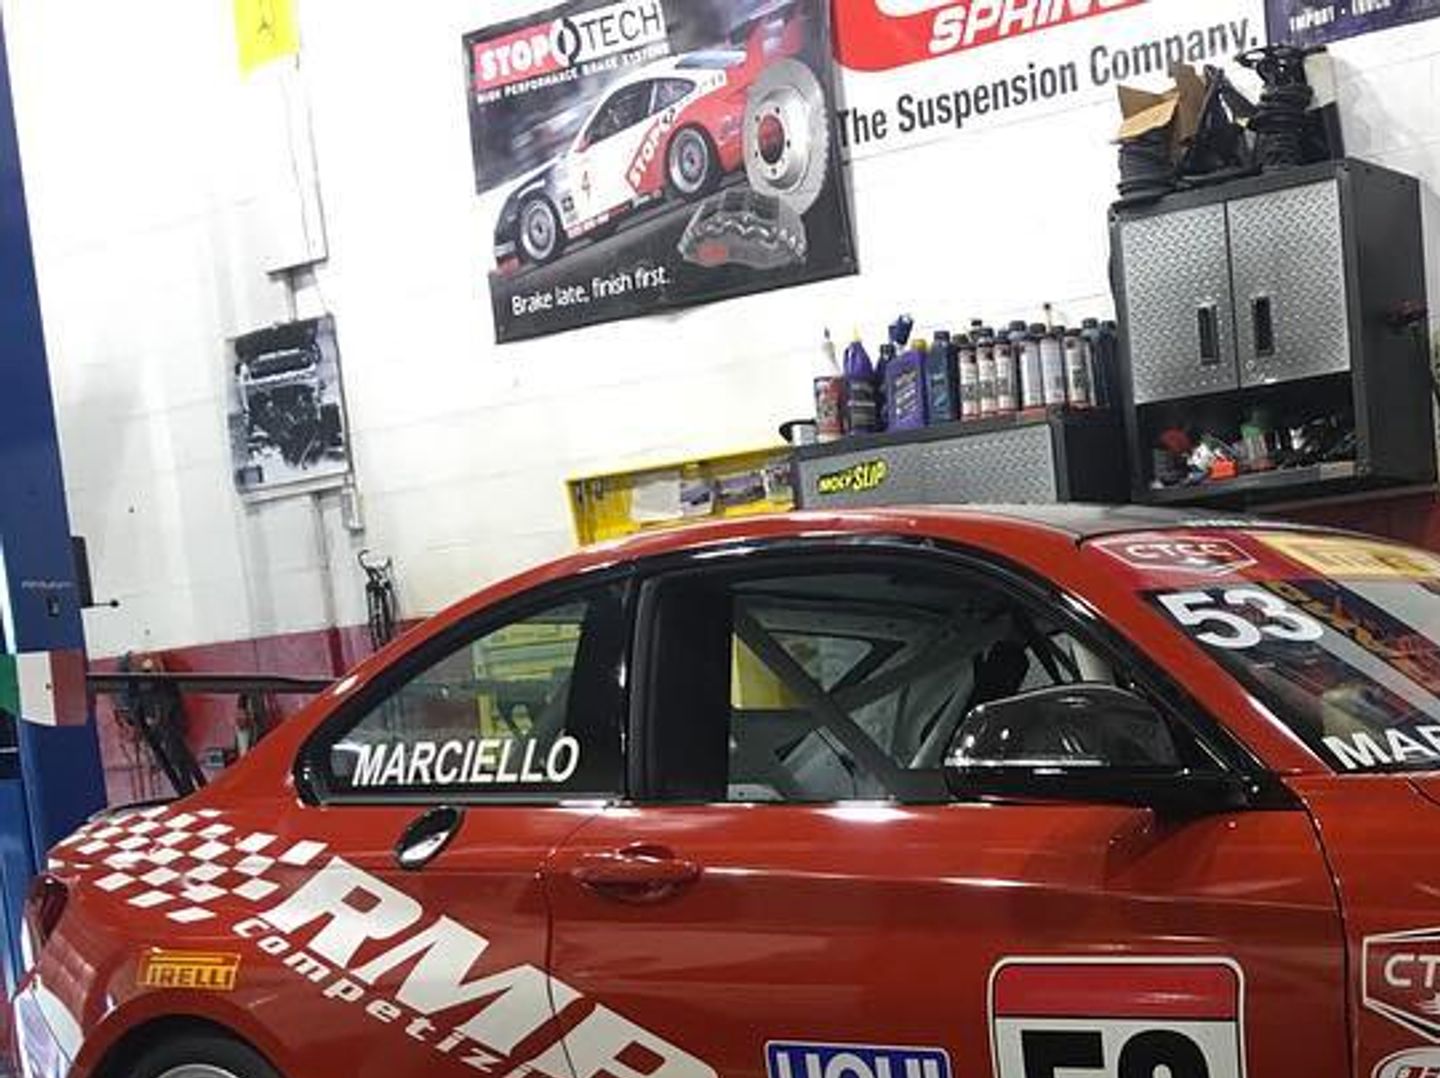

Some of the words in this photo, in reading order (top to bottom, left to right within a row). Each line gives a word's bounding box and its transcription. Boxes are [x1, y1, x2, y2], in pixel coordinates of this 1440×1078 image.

[836, 107, 888, 146] The
[896, 62, 1079, 132] Suspension
[1090, 18, 1259, 87] Company.
[511, 294, 553, 317] Brake
[592, 273, 633, 301] finish
[1157, 586, 1325, 651] 53
[351, 736, 580, 788] MARCIELLO
